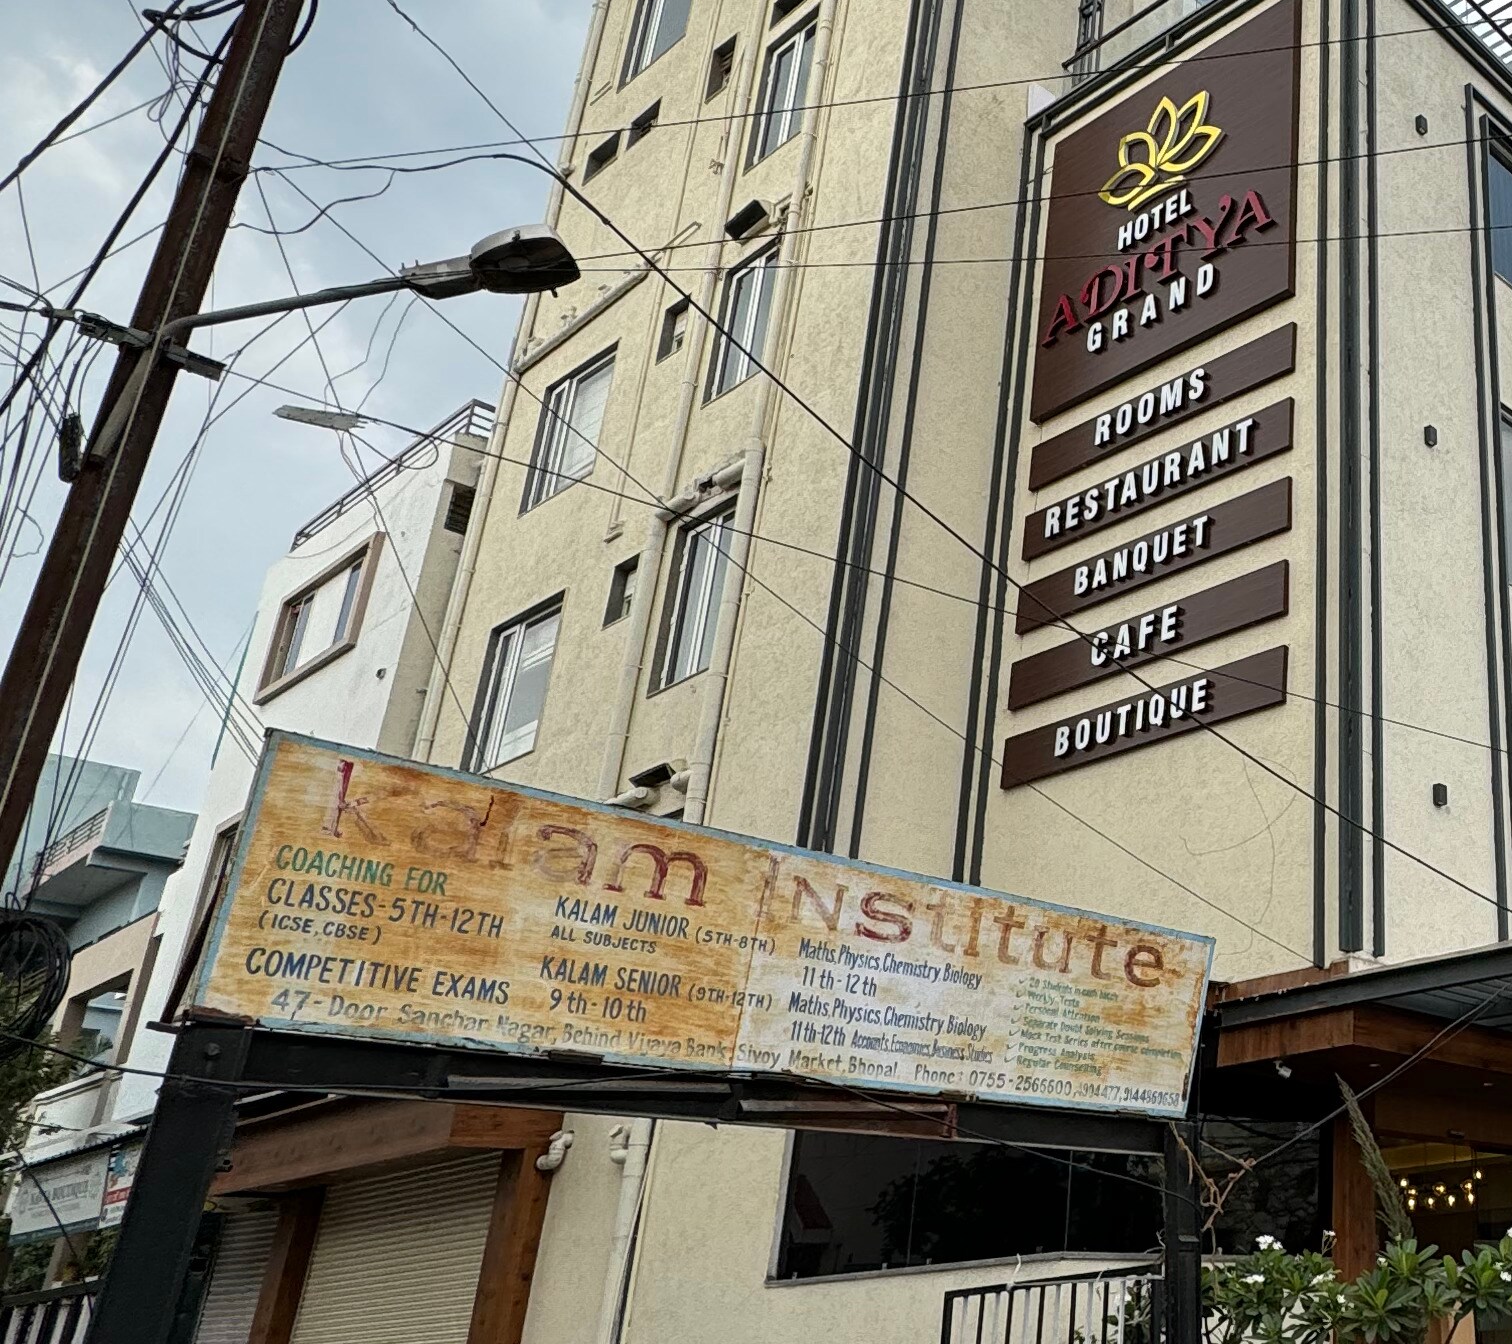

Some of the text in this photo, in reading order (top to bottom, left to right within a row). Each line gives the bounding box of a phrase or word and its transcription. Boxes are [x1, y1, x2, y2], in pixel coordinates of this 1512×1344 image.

[1118, 189, 1191, 251] HOTEL
[1042, 189, 1272, 345] ADITYA
[1086, 263, 1214, 353] GRAND
[1094, 368, 1205, 446] ROOMS
[1045, 418, 1253, 538] RESTAURANT
[1074, 515, 1208, 595] BANQUET
[1090, 605, 1178, 666] CAFE
[1054, 678, 1207, 757] BOUTIQUE
[275, 844, 449, 897] COACHING FOR
[551, 925, 657, 954] ALL SUBJECTS
[554, 895, 618, 928] KALAM
[623, 908, 690, 940] JUNIOR
[245, 947, 511, 1005] COMPETITIVE EXAMS
[540, 955, 609, 988] KALAM
[614, 966, 682, 999] SENIOR
[562, 1023, 622, 1049] Behind
